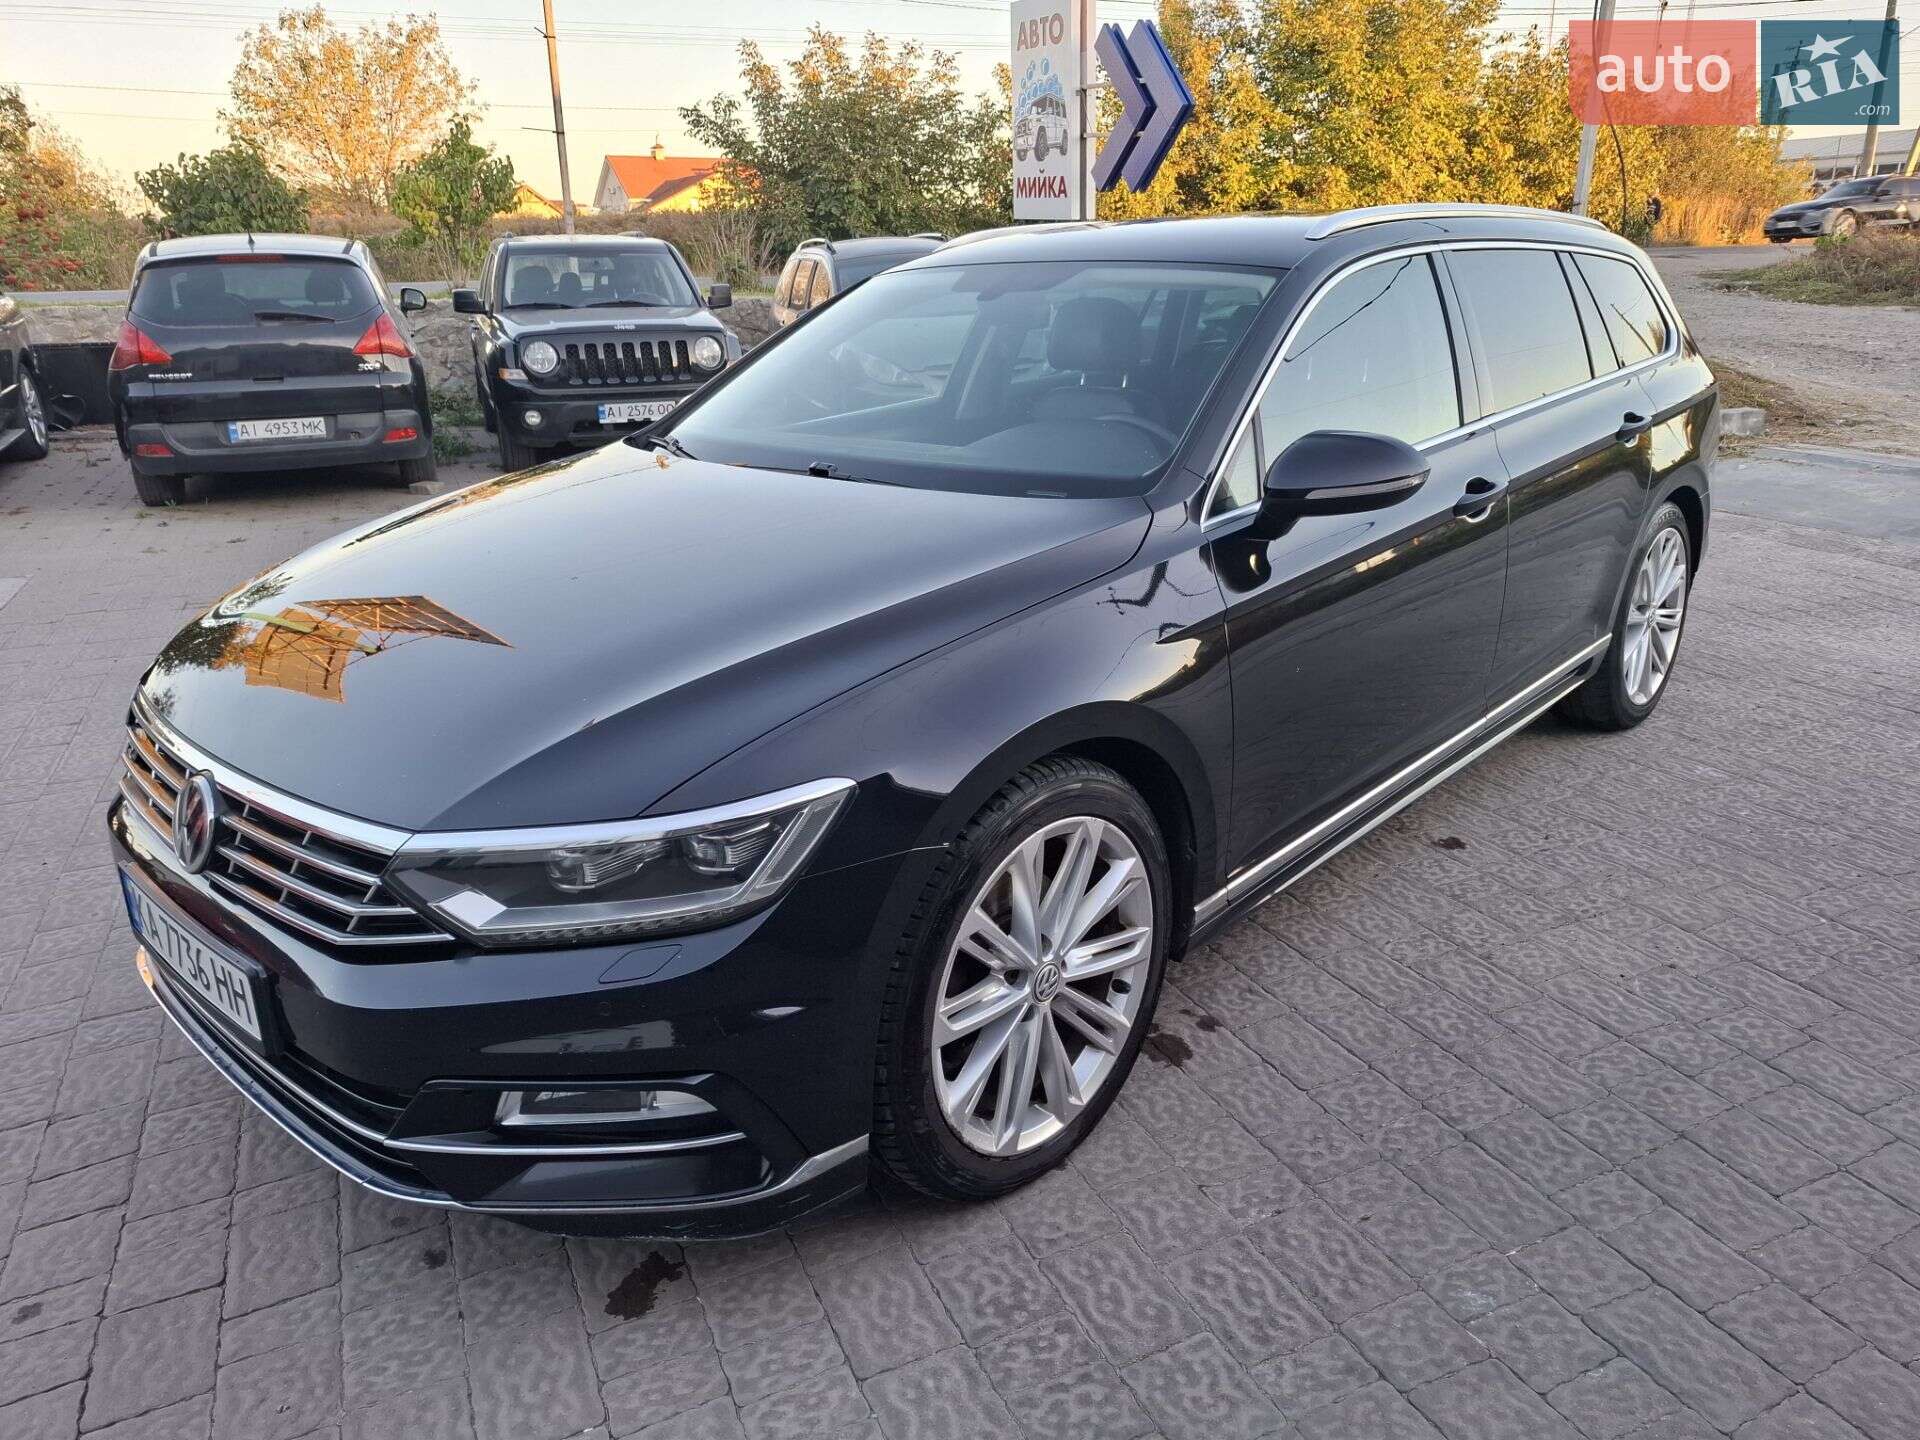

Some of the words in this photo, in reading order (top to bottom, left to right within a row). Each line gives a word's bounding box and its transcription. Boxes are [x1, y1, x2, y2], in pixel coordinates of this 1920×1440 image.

[1017, 13, 1064, 50] АВТО
[1016, 168, 1068, 199] МИЙКА
[607, 406, 622, 418] AI
[627, 405, 654, 417] 2576
[240, 423, 257, 437] AI
[264, 421, 299, 435] 4953
[302, 420, 323, 433] MK
[159, 914, 210, 991] 7736
[210, 957, 252, 1026] HH
